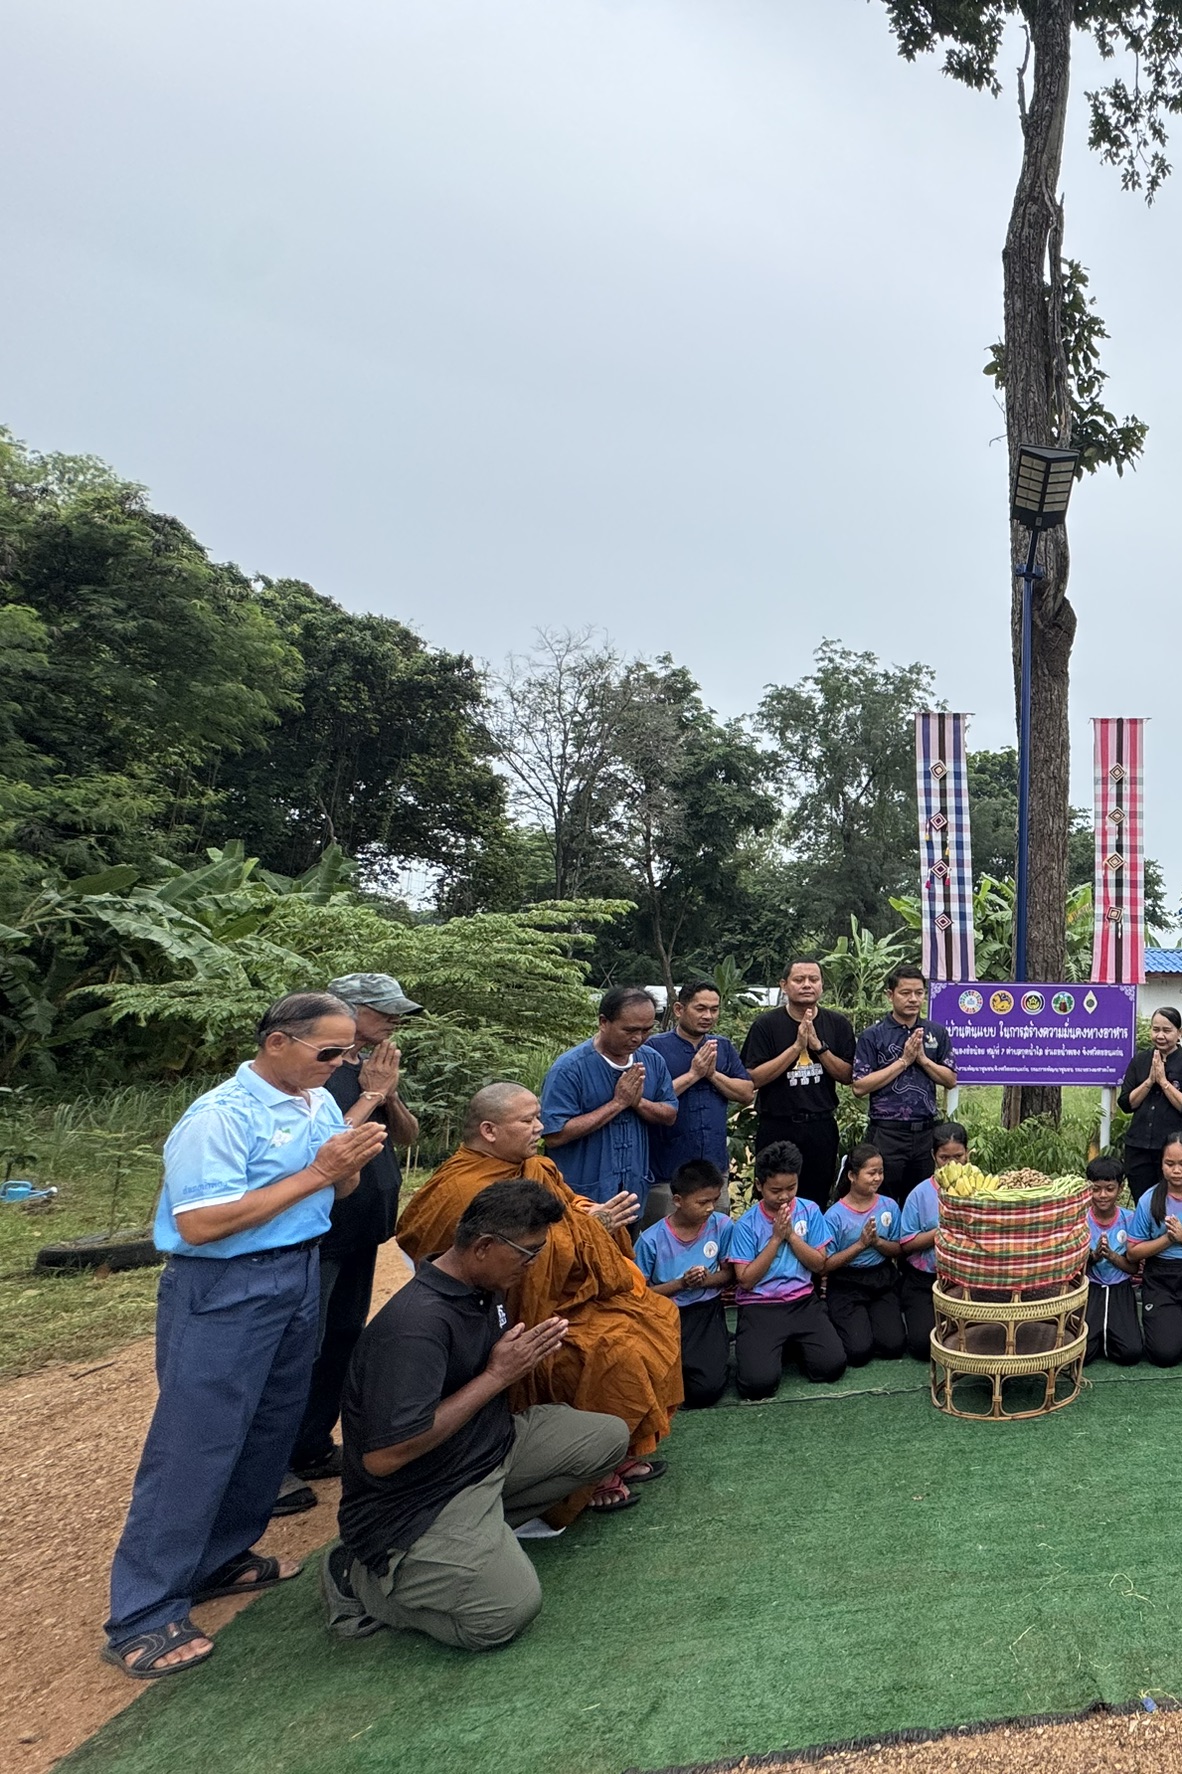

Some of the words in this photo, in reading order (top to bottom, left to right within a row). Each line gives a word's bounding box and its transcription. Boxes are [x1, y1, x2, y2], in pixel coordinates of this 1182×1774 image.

[945, 1019, 997, 1039] ่บ้านต้นแบบ
[999, 1018, 1129, 1039] ในการสร้างความมั่นคงทางอาหาร
